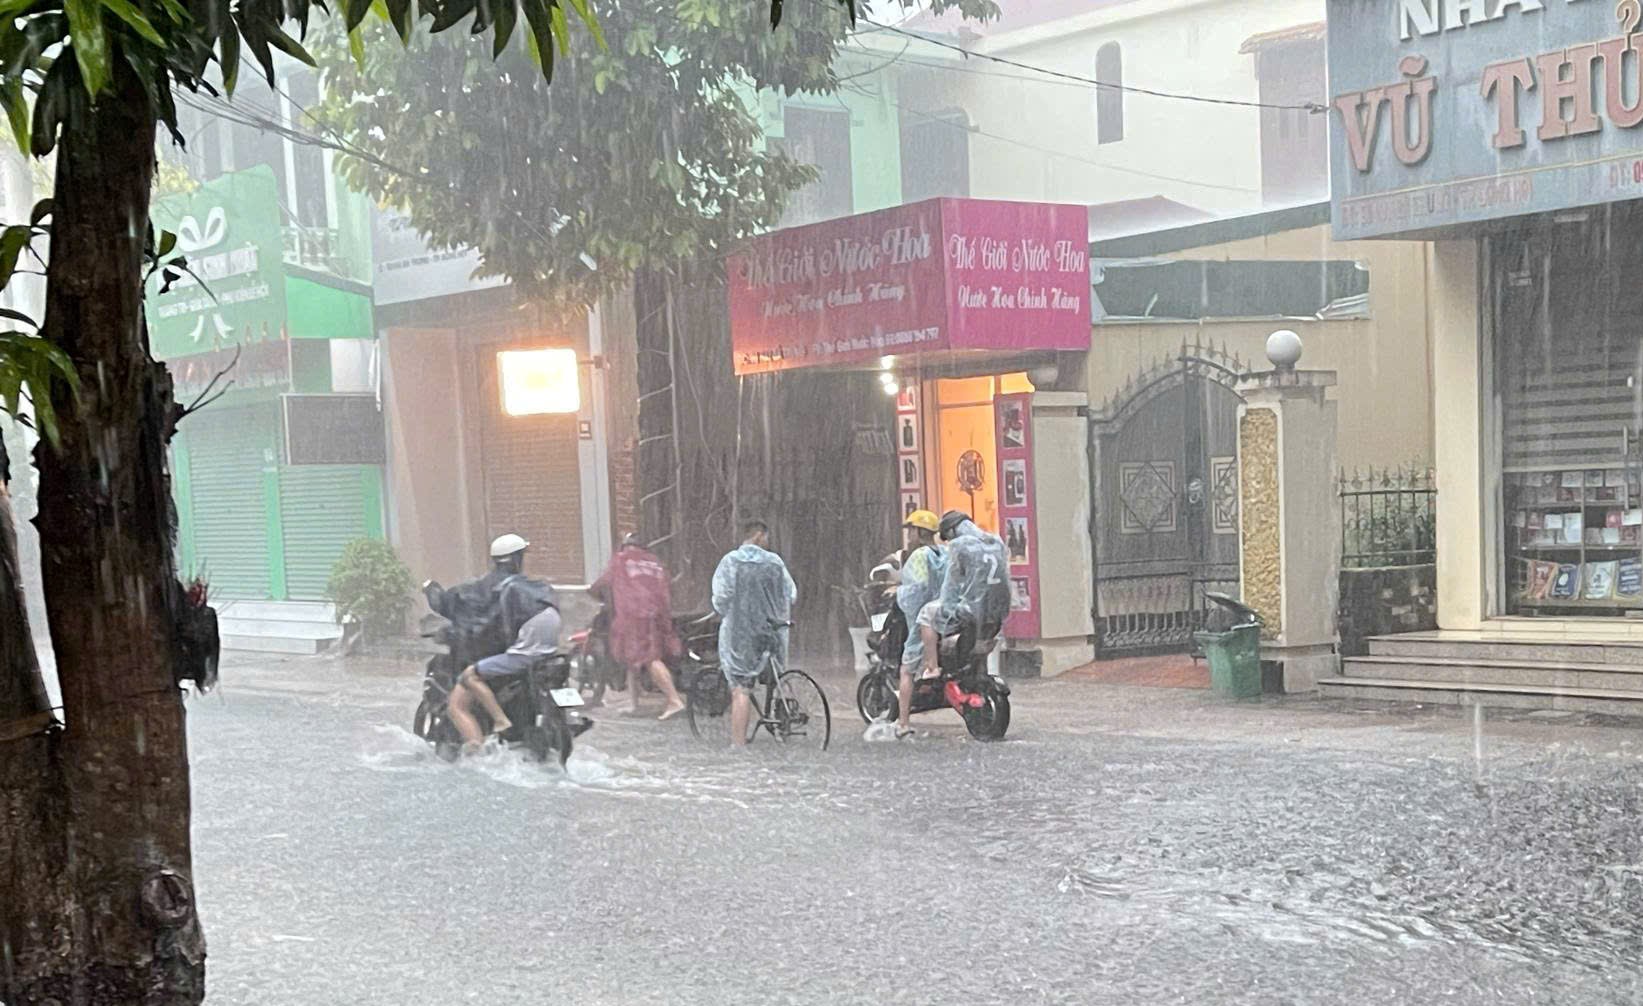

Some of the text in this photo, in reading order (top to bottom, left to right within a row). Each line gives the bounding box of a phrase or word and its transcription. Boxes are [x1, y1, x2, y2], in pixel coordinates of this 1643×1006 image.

[1335, 55, 1438, 171] VŨ
[1054, 240, 1085, 272] Hoa
[991, 286, 1015, 309] Hoa
[983, 553, 1000, 585] 2
